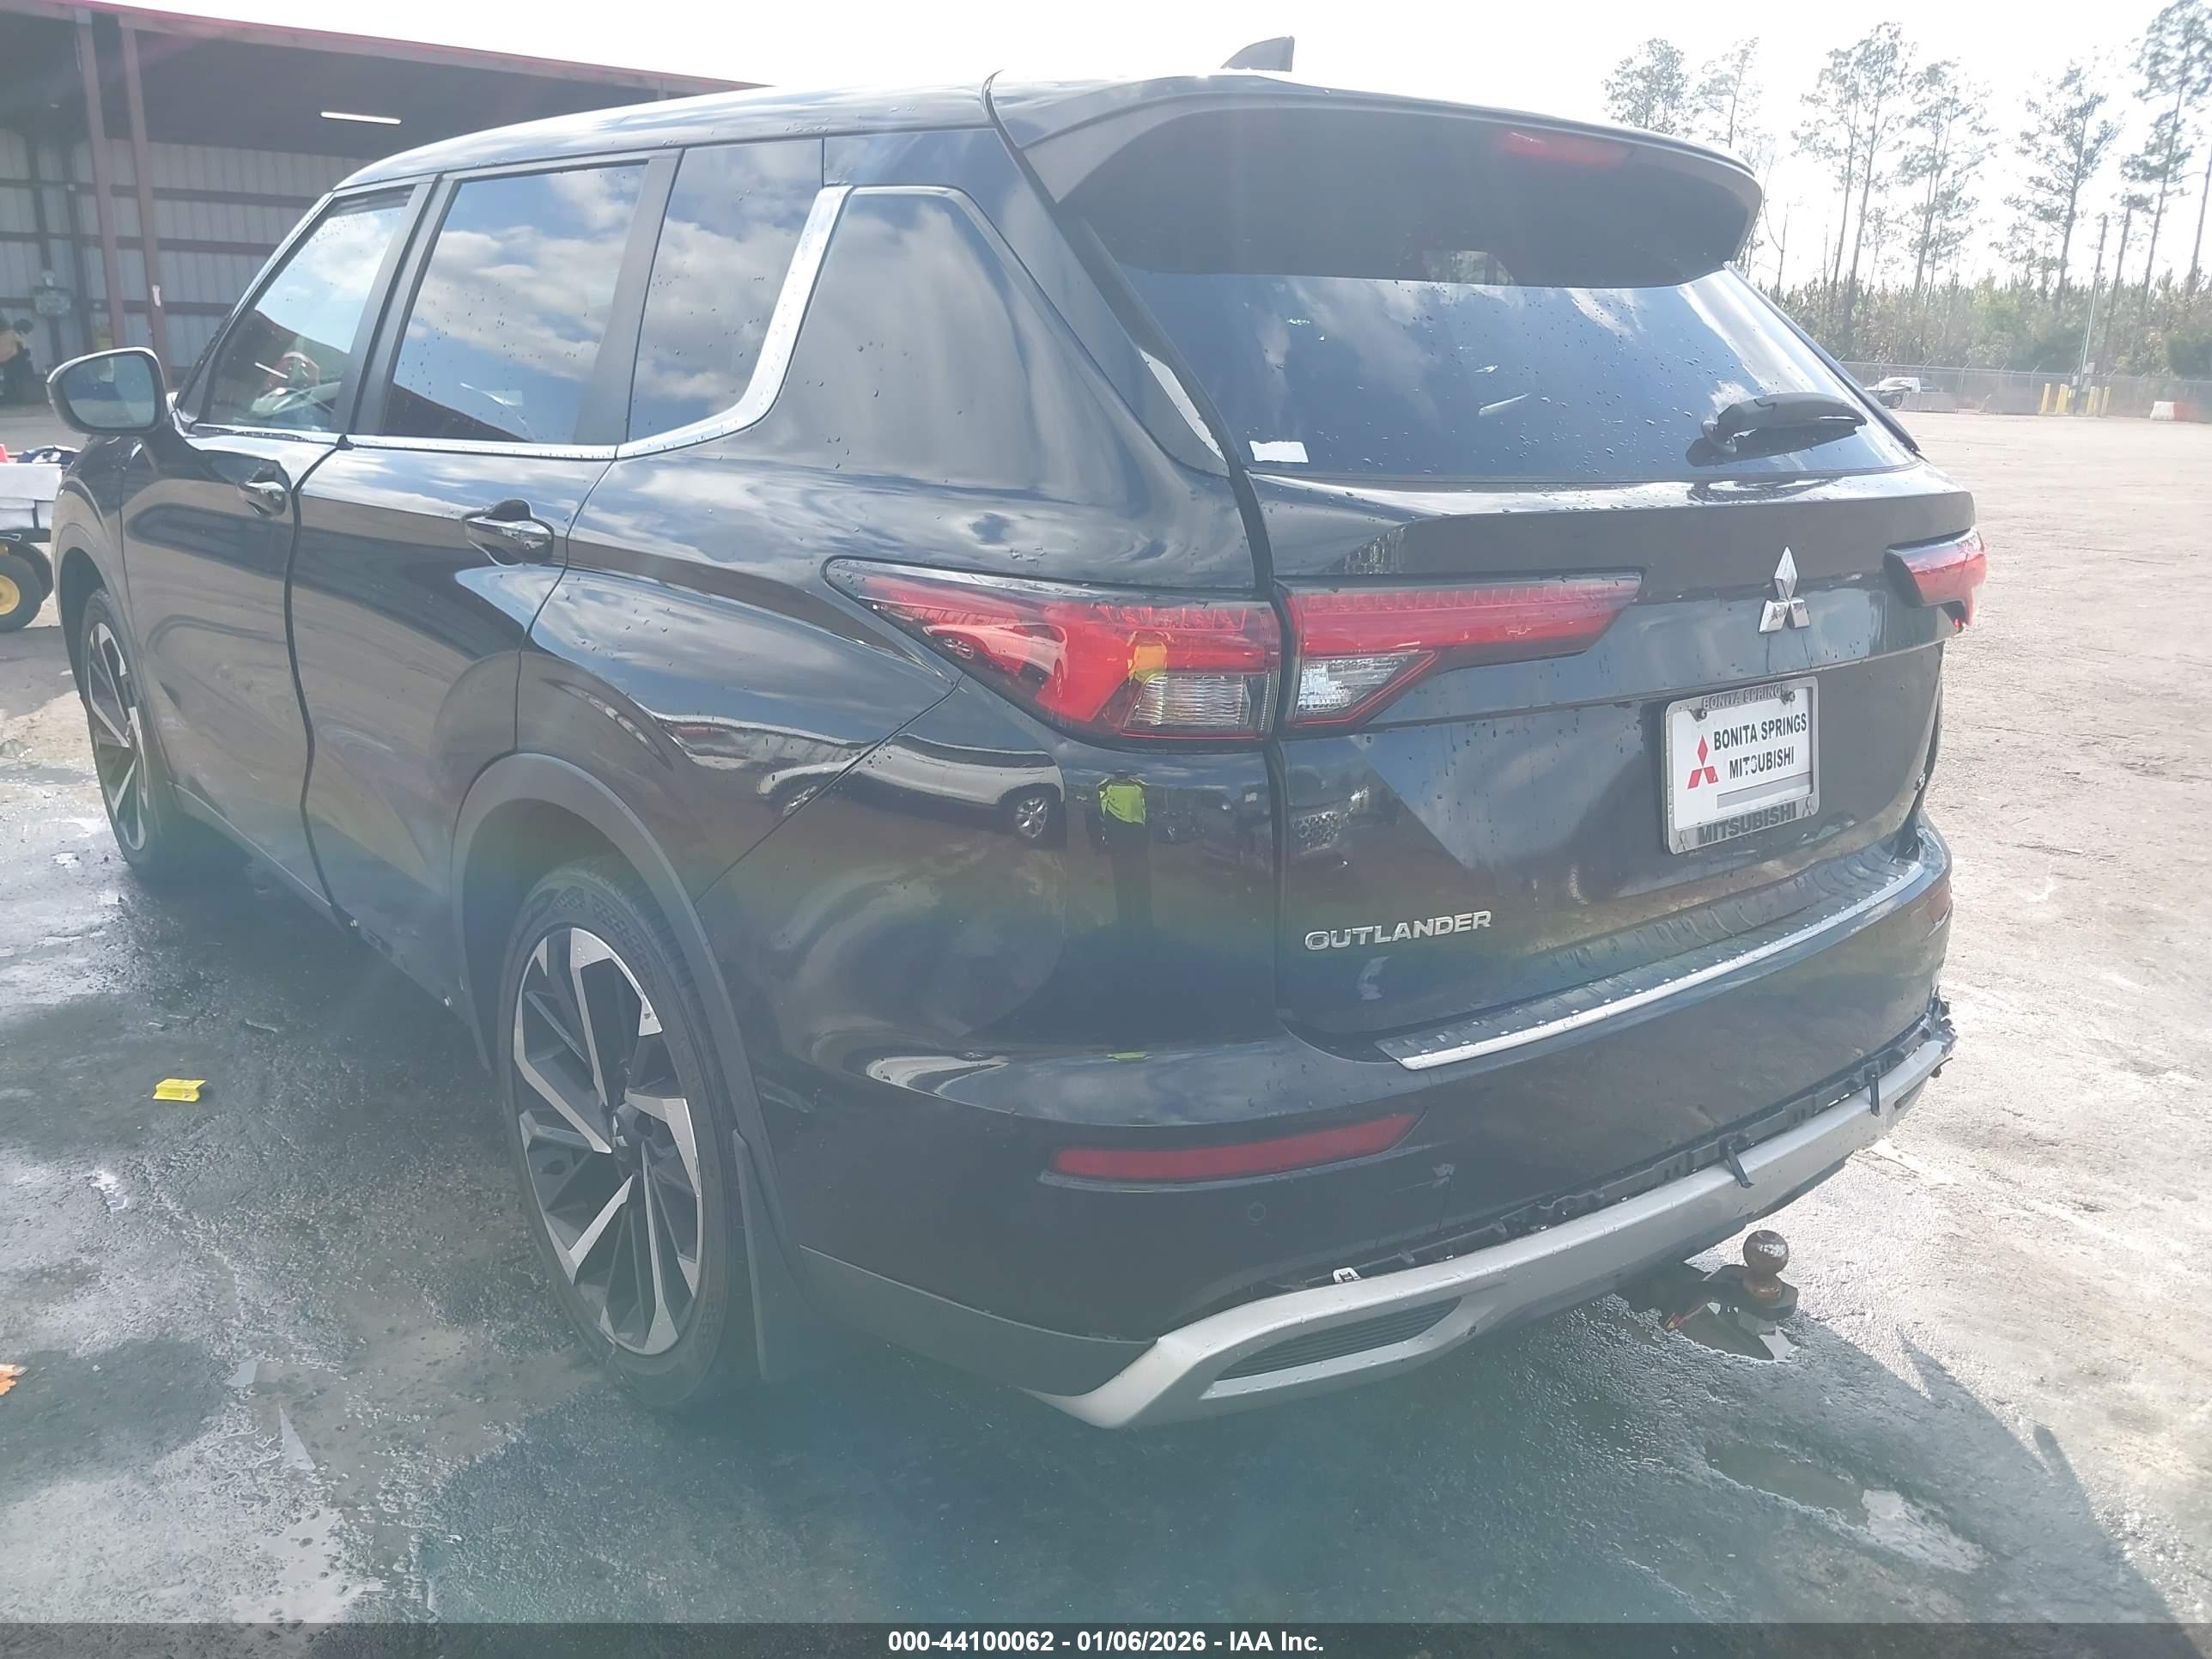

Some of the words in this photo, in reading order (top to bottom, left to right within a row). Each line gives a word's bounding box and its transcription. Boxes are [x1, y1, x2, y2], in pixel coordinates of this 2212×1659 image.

[1702, 692, 1740, 709] BONITA
[1714, 724, 1758, 750] BONITA
[1760, 713, 1807, 740] SPRINGS
[1729, 745, 1794, 779] MITSUBISHI
[1698, 802, 1796, 844] MITSUBISHI
[1304, 910, 1492, 951] OUTLANDER
